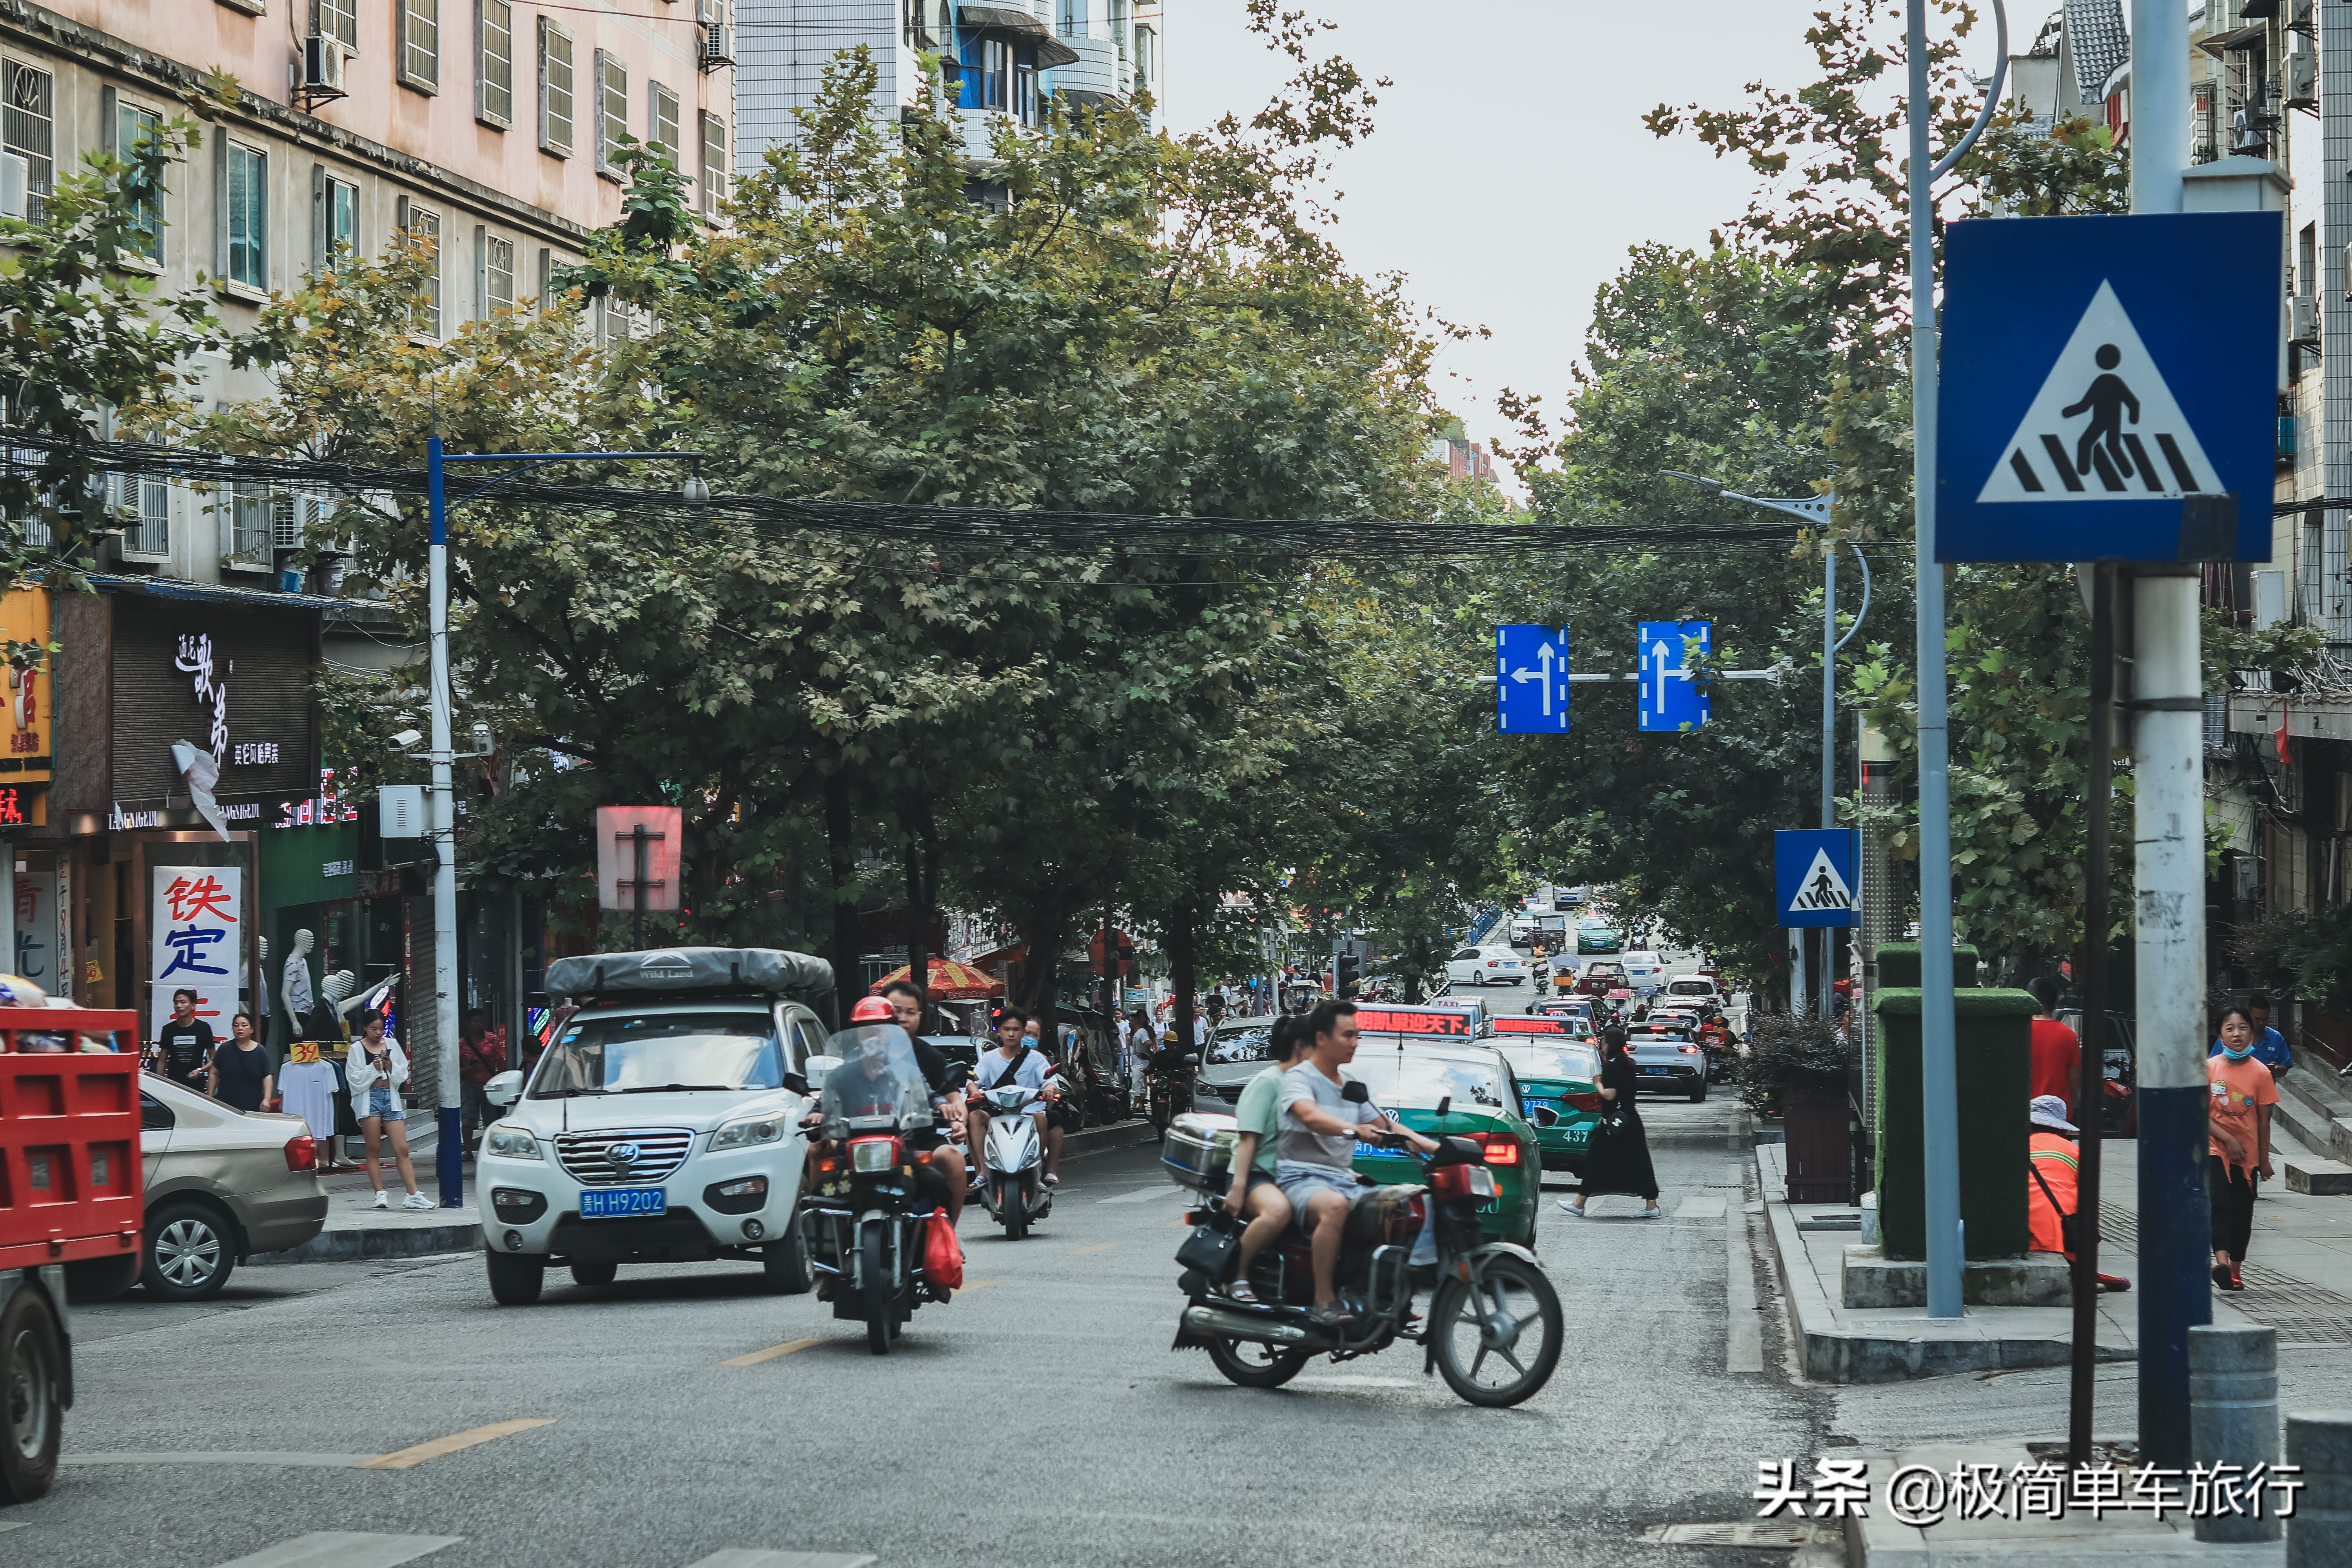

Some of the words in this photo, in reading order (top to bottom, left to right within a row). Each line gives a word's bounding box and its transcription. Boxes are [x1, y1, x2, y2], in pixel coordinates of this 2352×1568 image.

[234, 743, 279, 765] 英伦风格男装
[640, 970, 664, 978] Wild
[668, 970, 694, 978] Land
